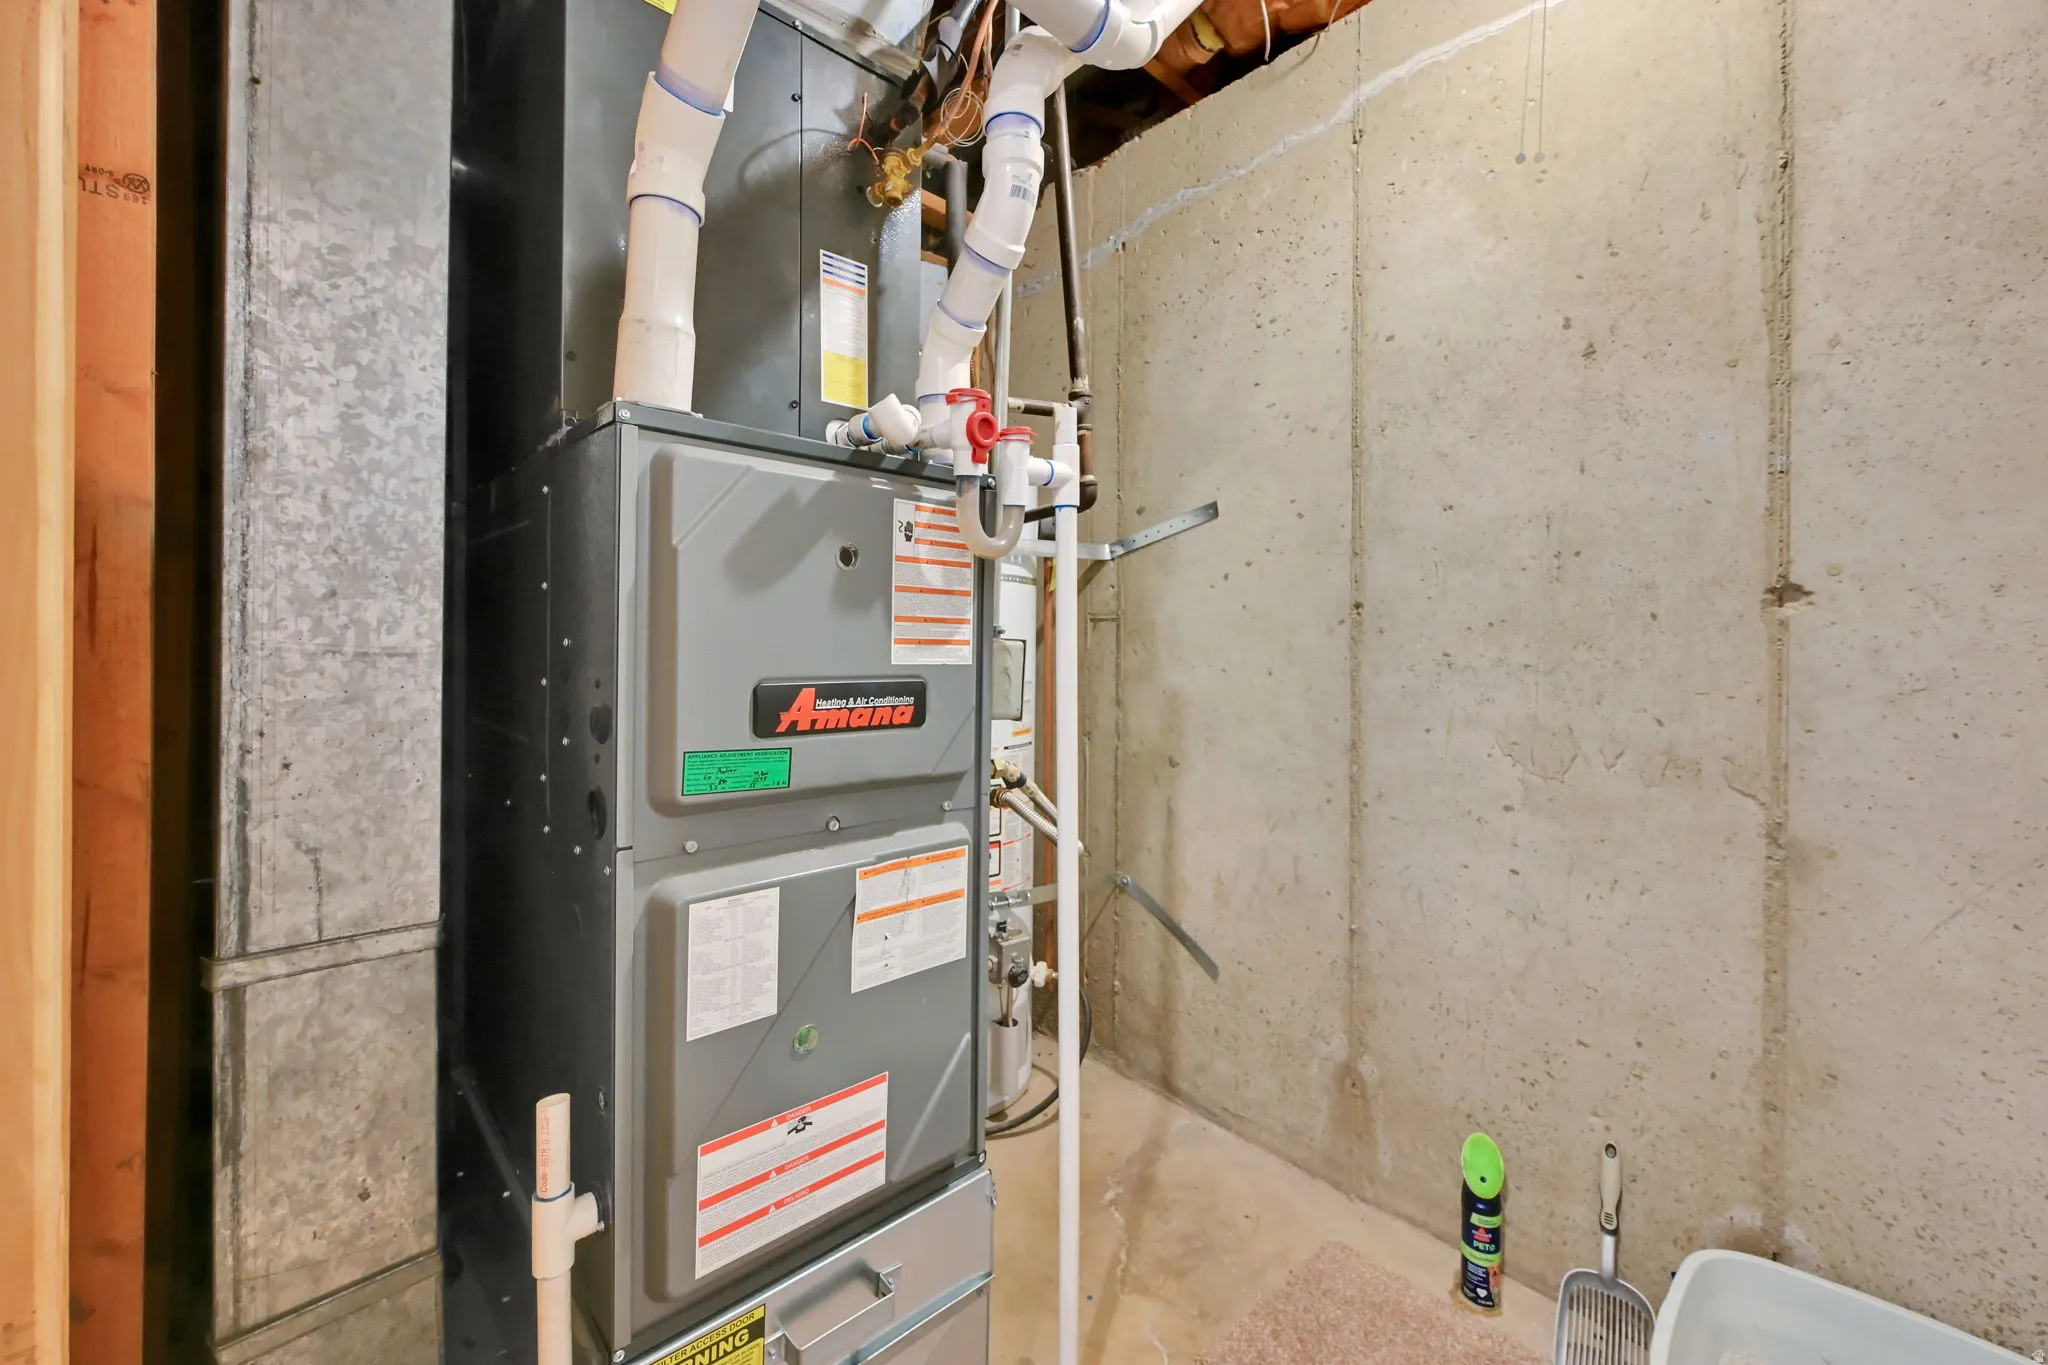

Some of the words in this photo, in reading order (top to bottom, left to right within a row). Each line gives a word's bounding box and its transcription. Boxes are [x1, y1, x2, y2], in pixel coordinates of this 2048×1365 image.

[775, 687, 914, 733] Amana
[816, 698, 847, 709] Heating
[848, 697, 854, 706] &
[855, 697, 867, 706] Air
[868, 695, 915, 706] Conditioning
[786, 1105, 812, 1120] DANGER
[784, 1155, 810, 1171] DANGER
[783, 1188, 810, 1205] PELIGRO
[656, 1348, 688, 1365] ILTER
[689, 1327, 727, 1353] ACCESS
[729, 1312, 755, 1332] DOOR
[680, 1328, 749, 1365] NING
